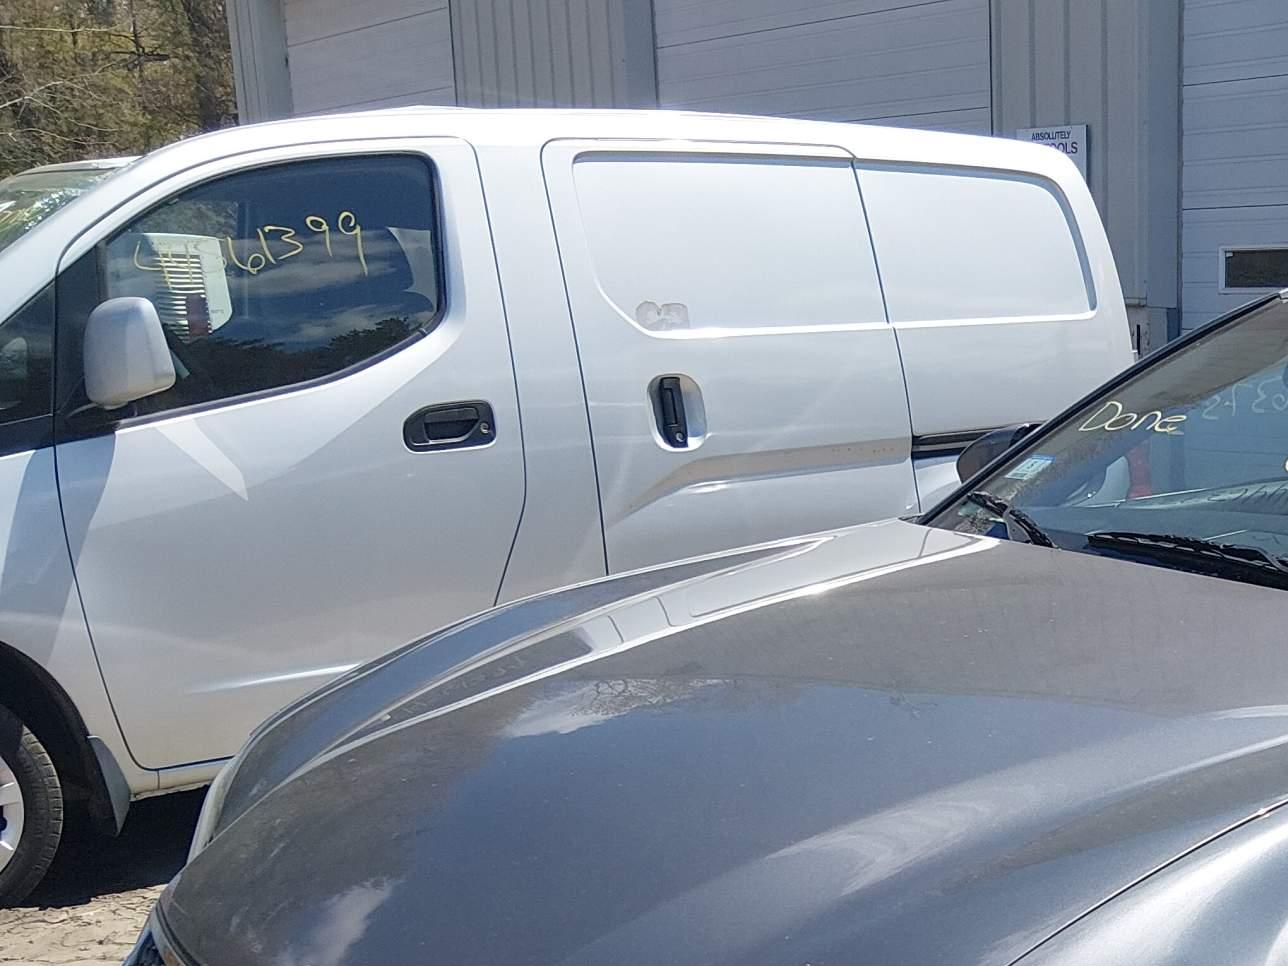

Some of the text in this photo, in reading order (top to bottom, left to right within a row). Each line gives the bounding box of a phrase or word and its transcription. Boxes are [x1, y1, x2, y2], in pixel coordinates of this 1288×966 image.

[1031, 130, 1072, 141] ABSOLUTELY
[1047, 141, 1079, 155] OLS
[1078, 400, 1187, 433] Done
